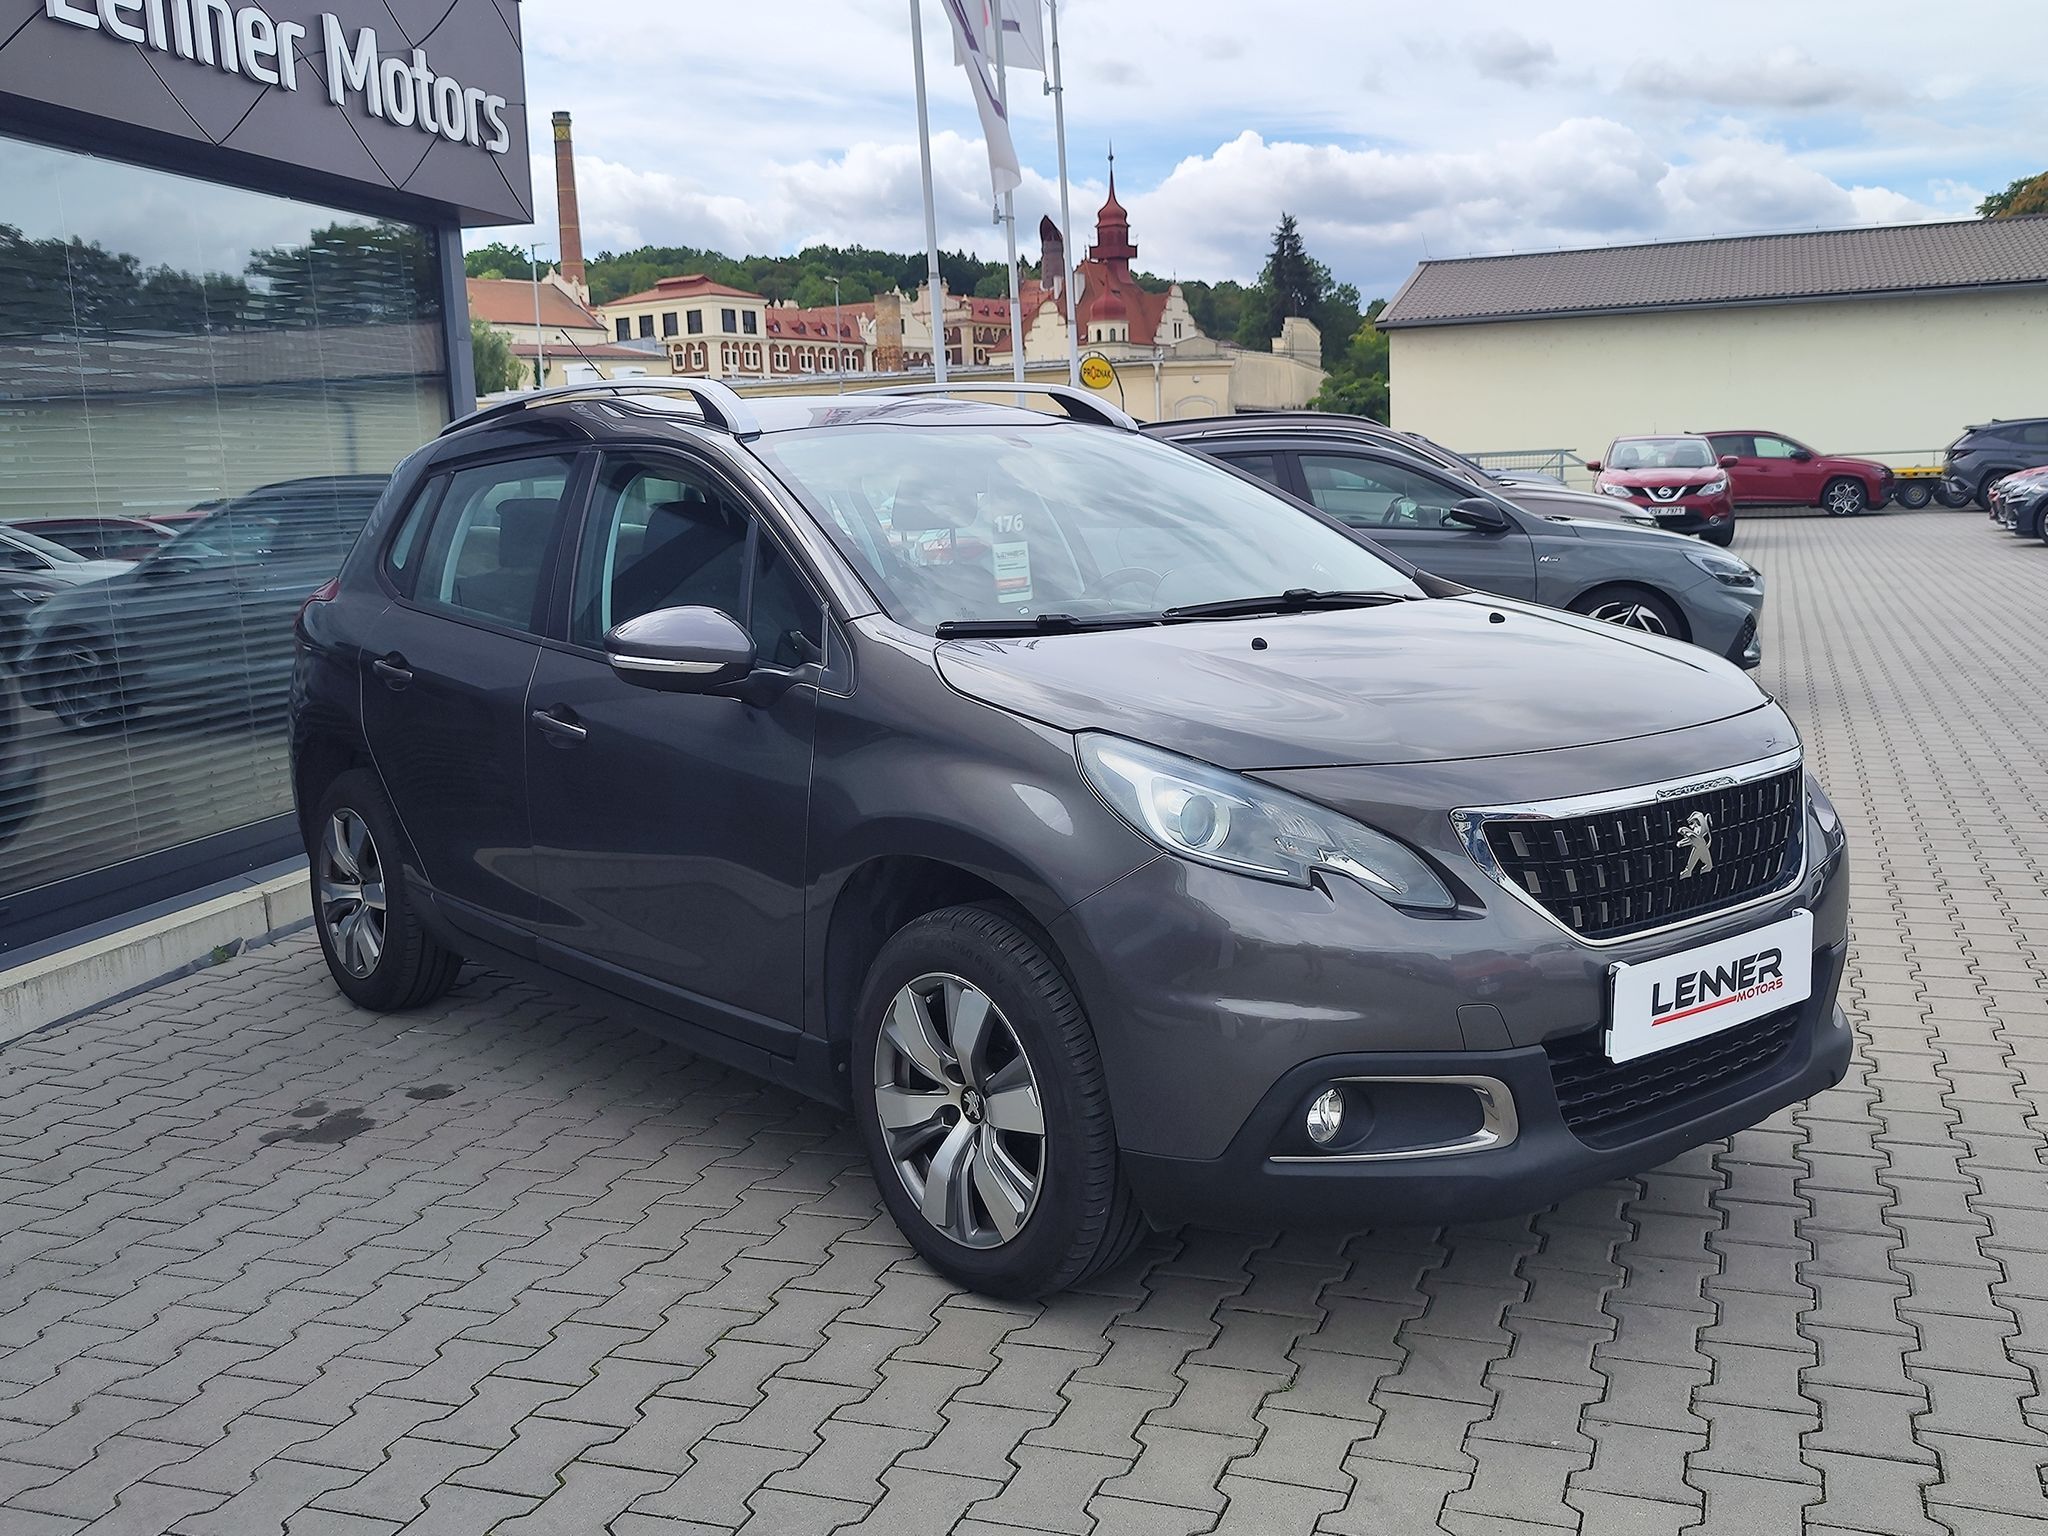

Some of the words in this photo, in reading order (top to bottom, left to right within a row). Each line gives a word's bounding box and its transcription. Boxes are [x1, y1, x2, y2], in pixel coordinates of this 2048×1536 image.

[321, 12, 512, 155] Motors
[994, 513, 1024, 533] 176
[1651, 948, 1784, 1017] LENNER
[1736, 978, 1784, 1003] MOTORS
